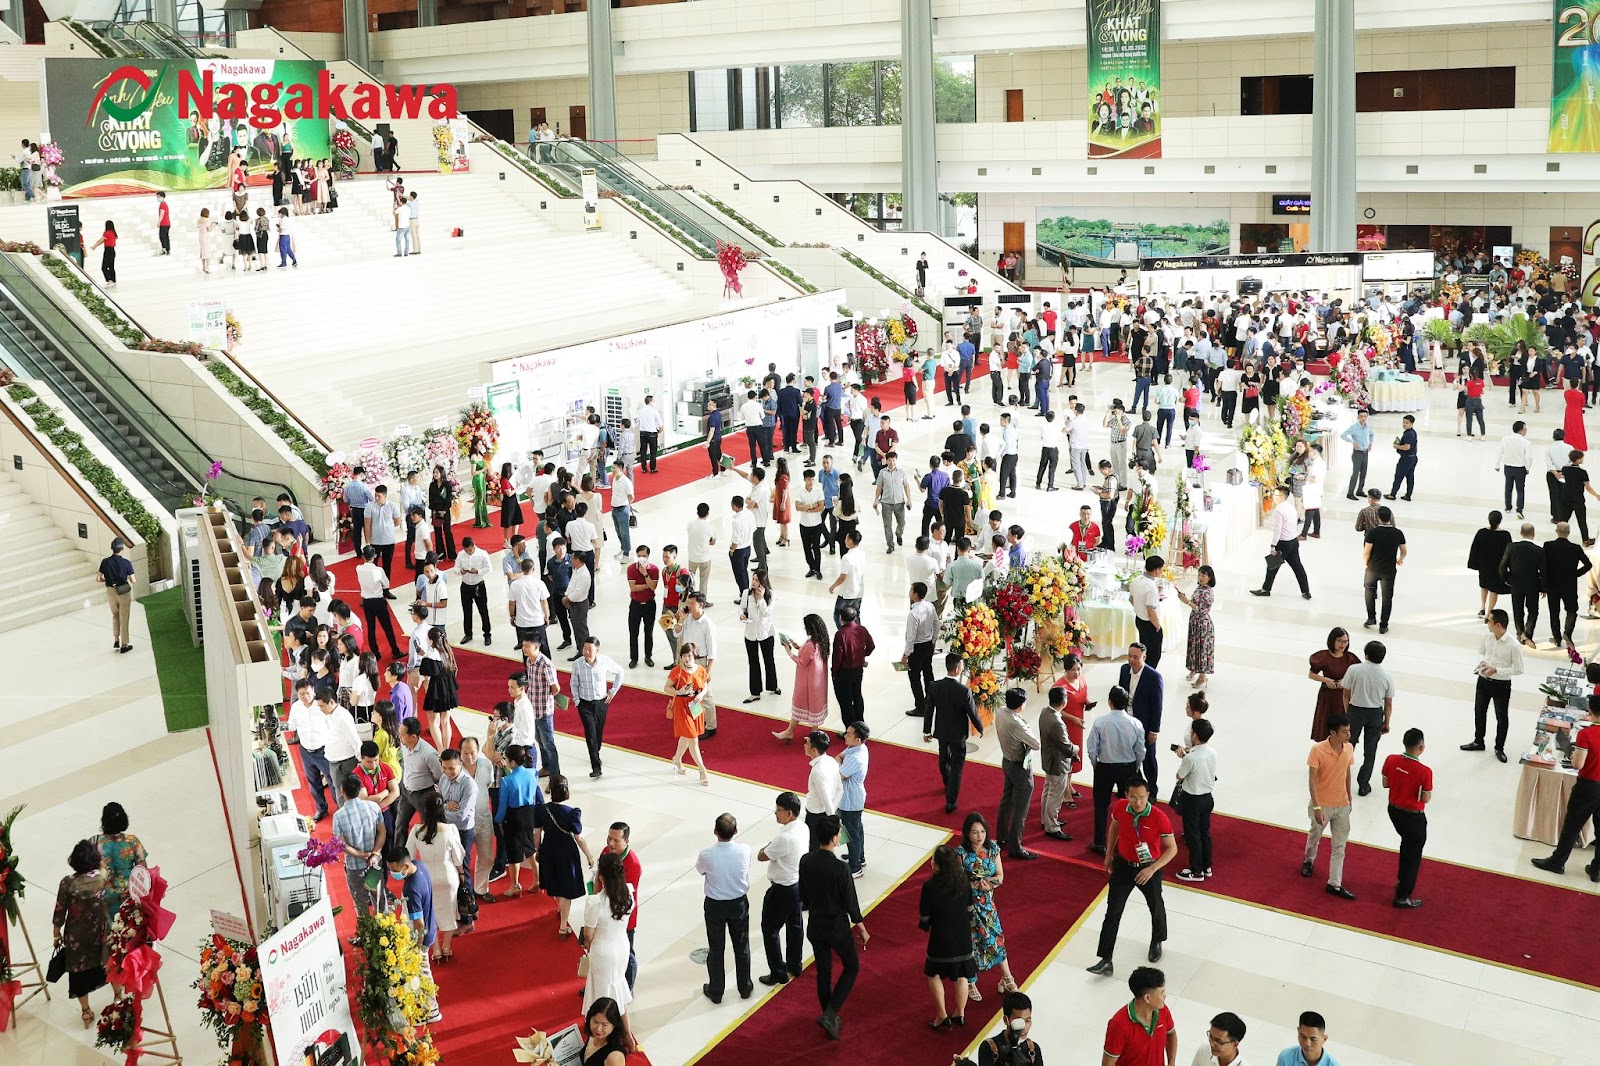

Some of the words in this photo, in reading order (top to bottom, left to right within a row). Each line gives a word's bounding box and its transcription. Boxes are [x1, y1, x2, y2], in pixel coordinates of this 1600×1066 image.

[1107, 14, 1141, 30] KHÁT
[1558, 6, 1600, 47] 2
[1110, 29, 1147, 44] VỌNG
[220, 63, 266, 76] Nagakawa
[116, 131, 161, 154] VỌNG
[1163, 260, 1197, 268] Nagakawa
[1314, 256, 1349, 264] Nagakawa
[615, 338, 647, 350] Nagakawa
[519, 358, 556, 372] Nagakawa
[280, 916, 325, 956] Nagakawa
